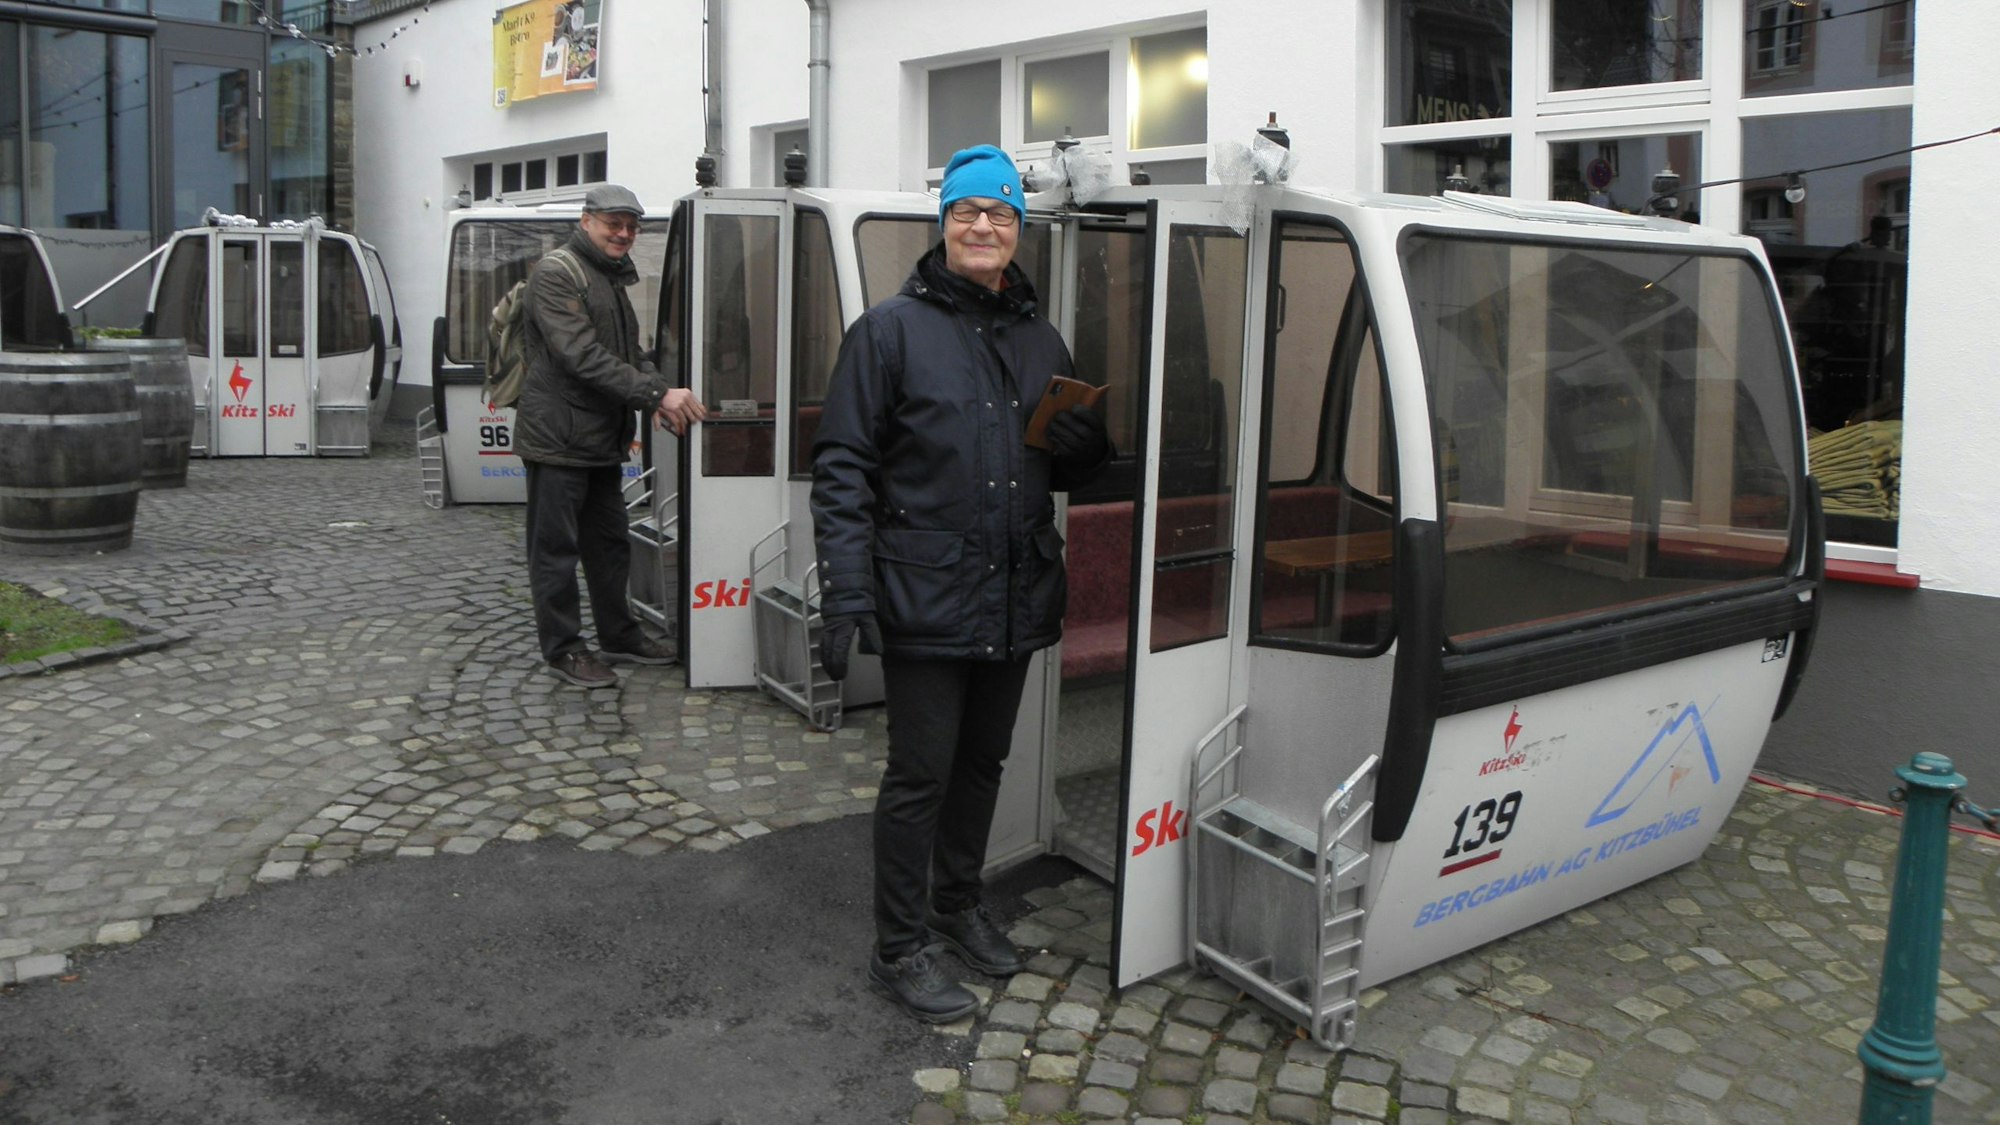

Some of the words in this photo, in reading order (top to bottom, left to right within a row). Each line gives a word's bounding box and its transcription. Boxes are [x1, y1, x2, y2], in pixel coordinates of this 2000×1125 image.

[222, 404, 258, 418] Kitz
[268, 403, 296, 418] Ski
[479, 416, 508, 424] KitzSki
[480, 425, 510, 447] 96
[692, 577, 752, 609] Ski
[1442, 790, 1524, 859] 139
[1413, 860, 1555, 928] BERGBAHN
[1554, 847, 1592, 878] AG
[1594, 805, 1702, 863] KITZBÜHEL
